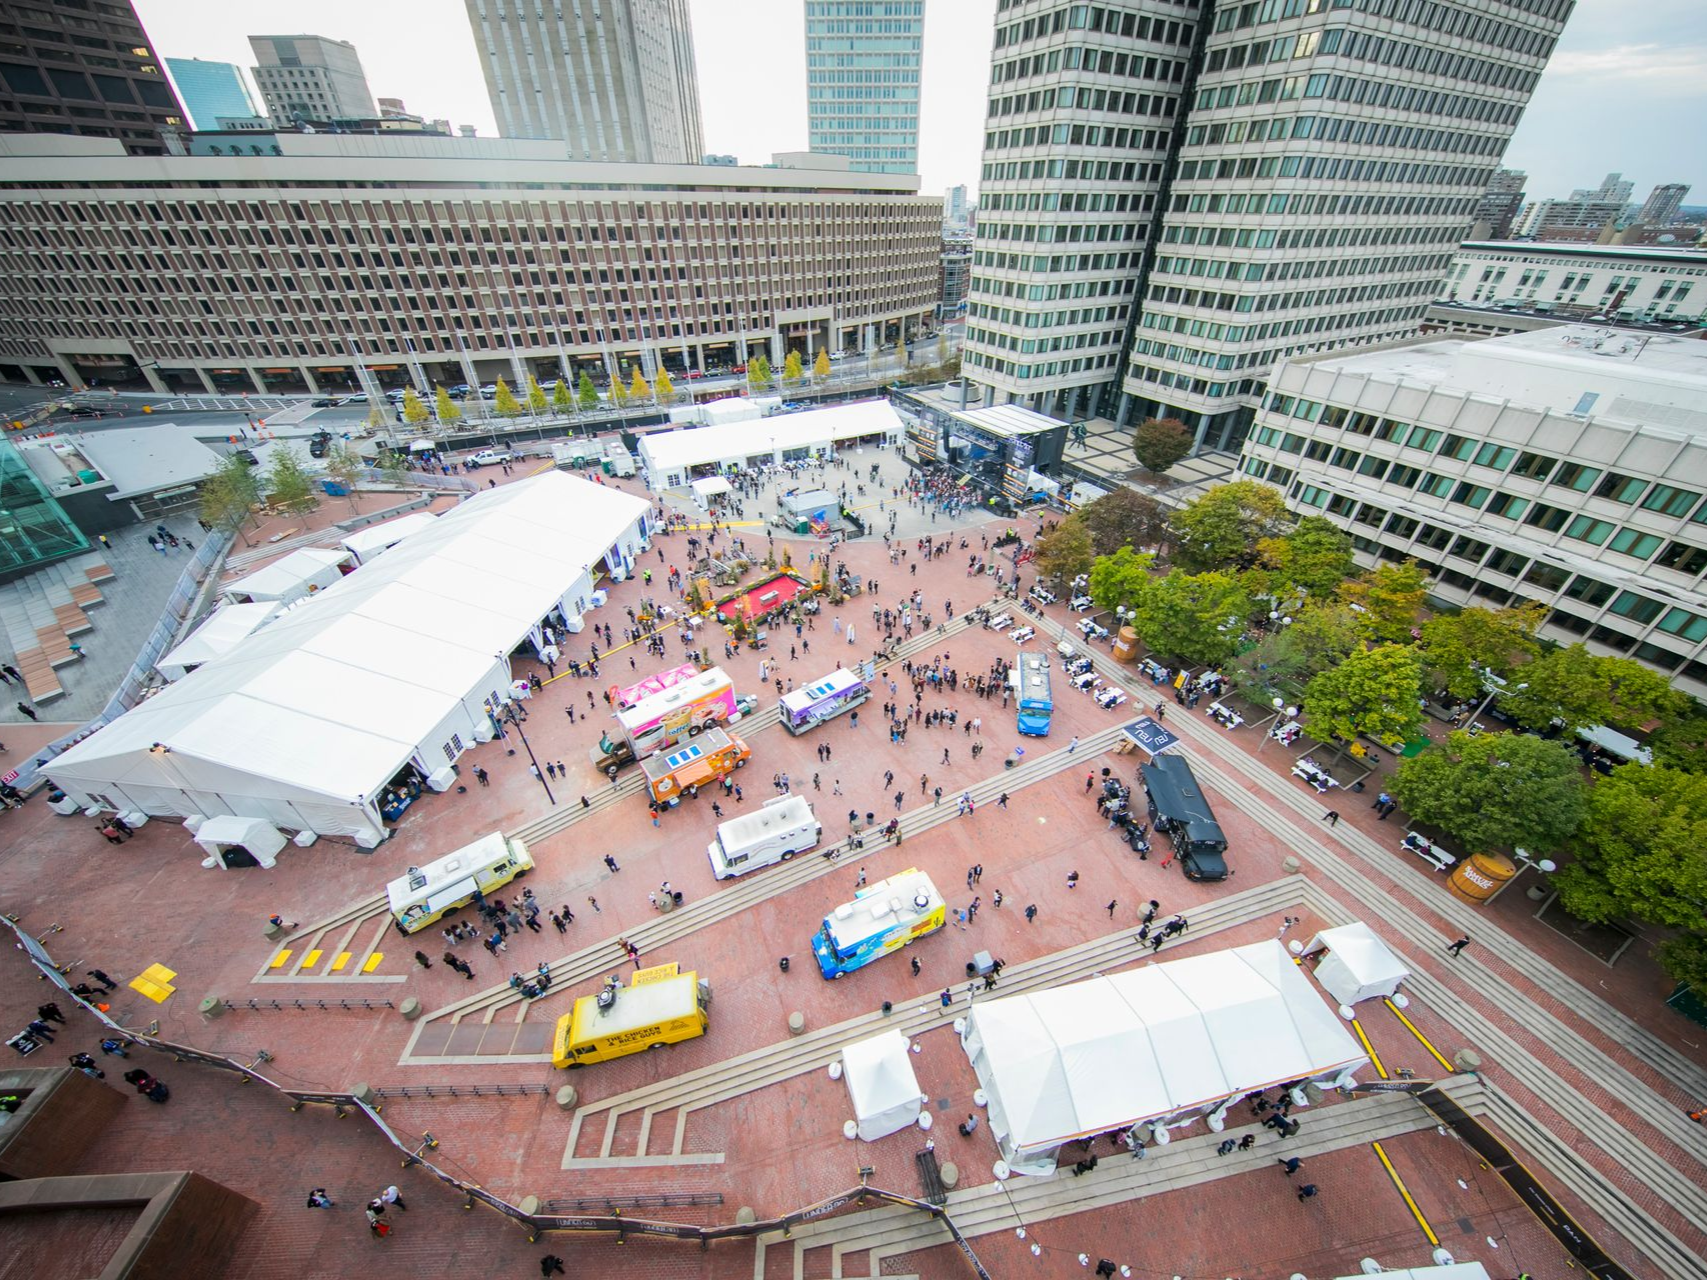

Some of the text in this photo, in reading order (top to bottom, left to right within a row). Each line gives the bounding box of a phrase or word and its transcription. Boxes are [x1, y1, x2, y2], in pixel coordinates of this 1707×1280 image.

[606, 1026, 660, 1043] THE CHICKEN
[640, 1030, 662, 1039] GUYS
